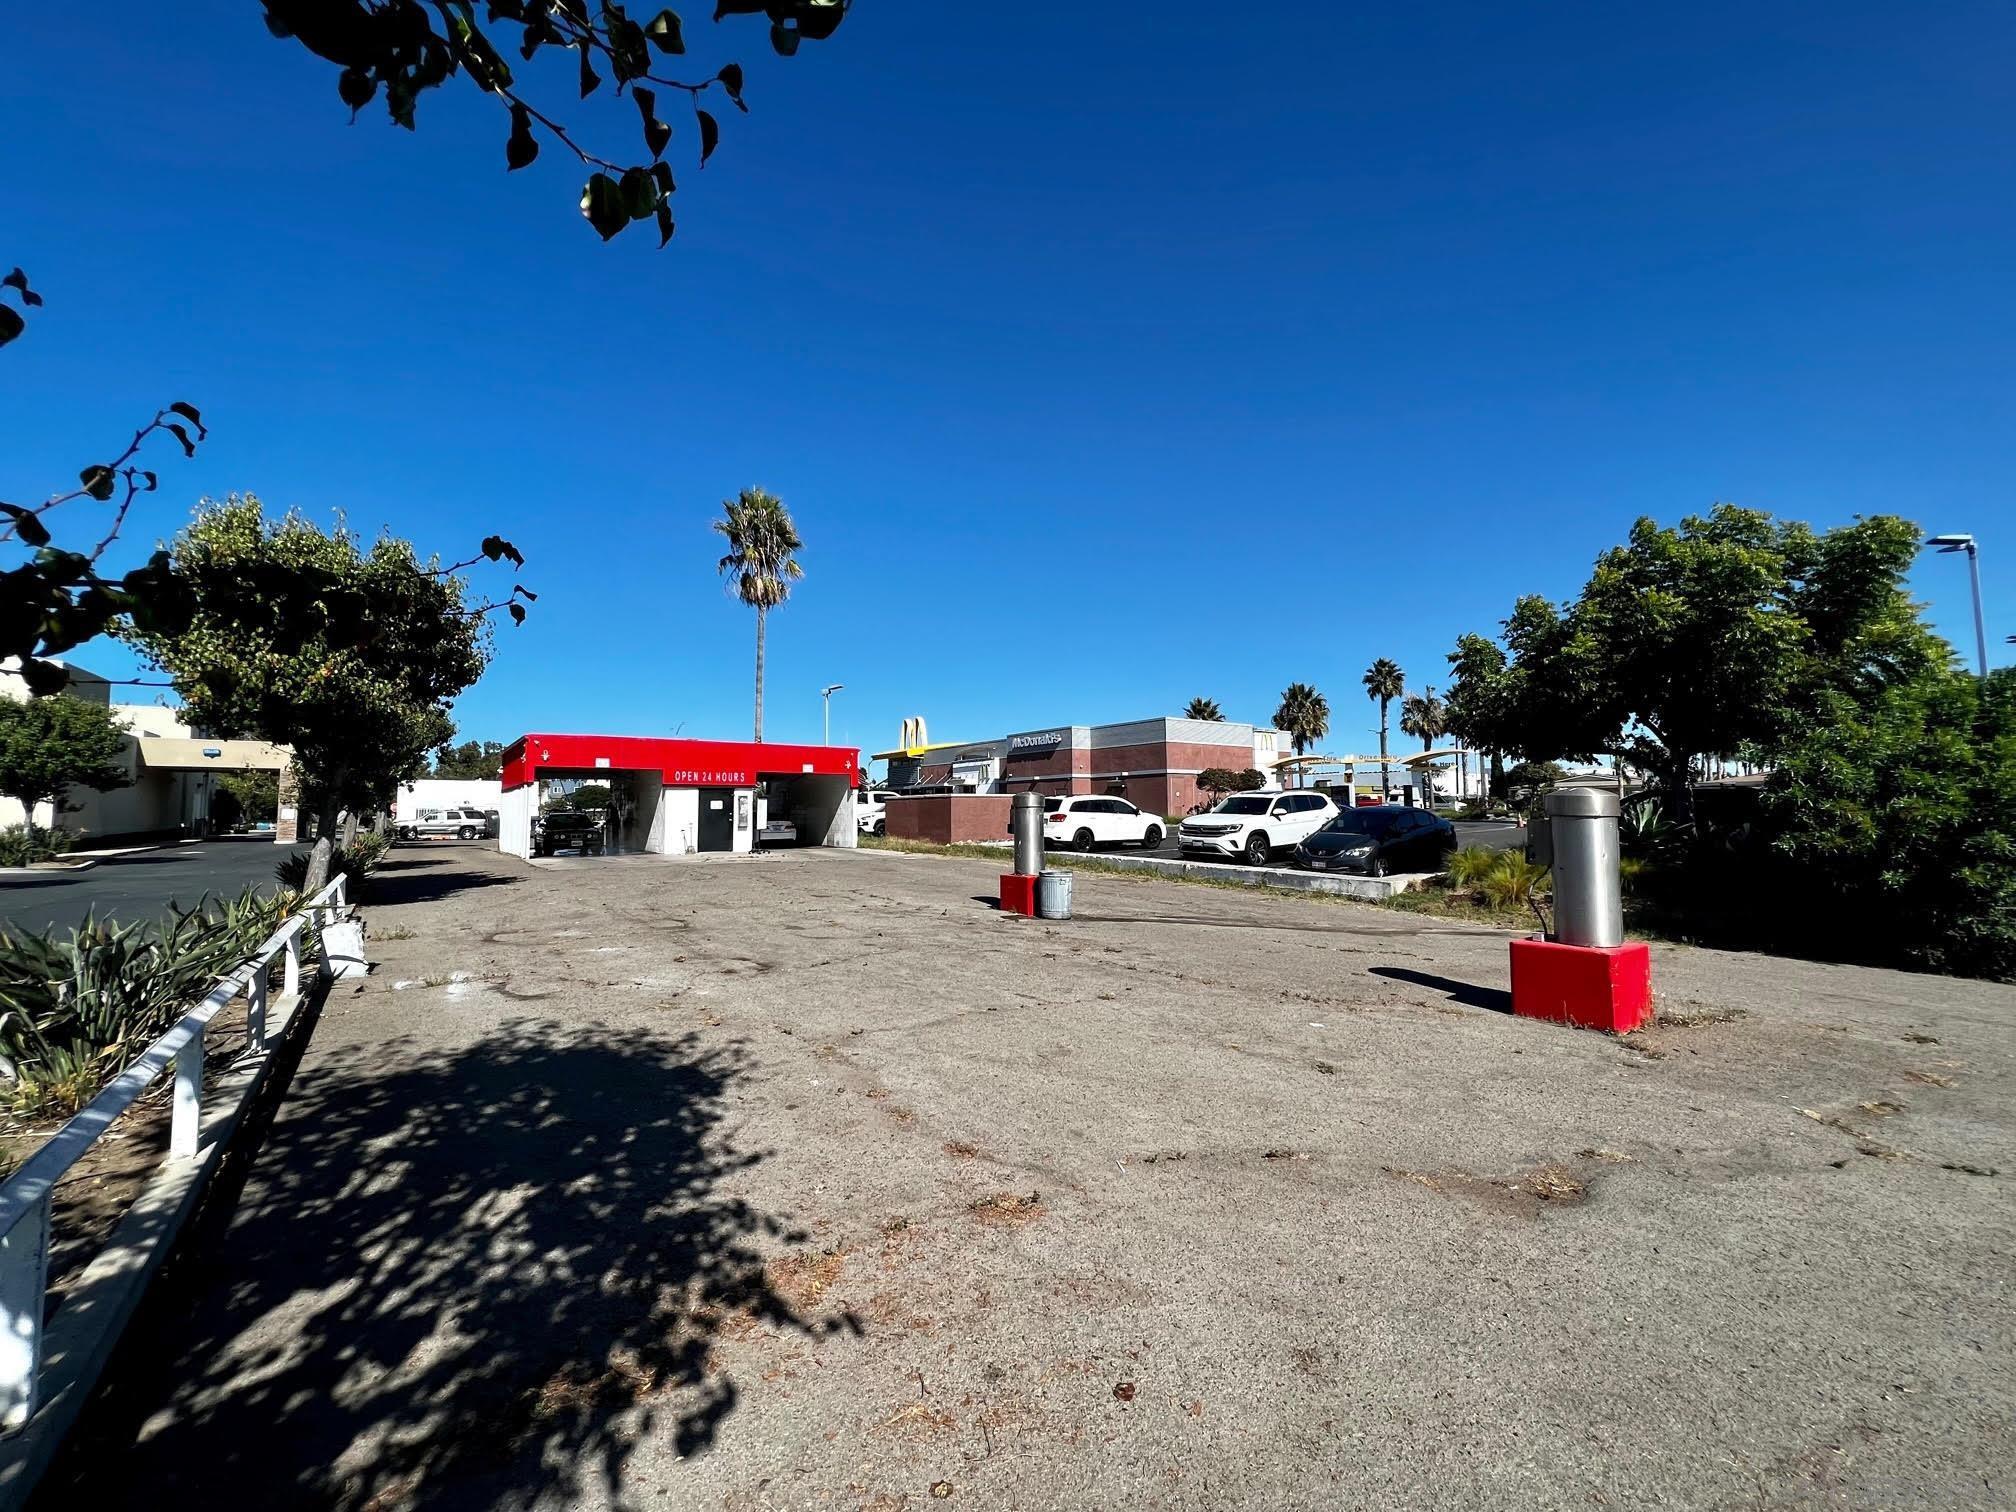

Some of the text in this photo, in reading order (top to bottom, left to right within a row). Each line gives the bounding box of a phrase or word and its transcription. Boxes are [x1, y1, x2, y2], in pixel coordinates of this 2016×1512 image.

[1012, 732, 1062, 748] McDonald's
[674, 771, 745, 782] OPEN 24 HOURS
